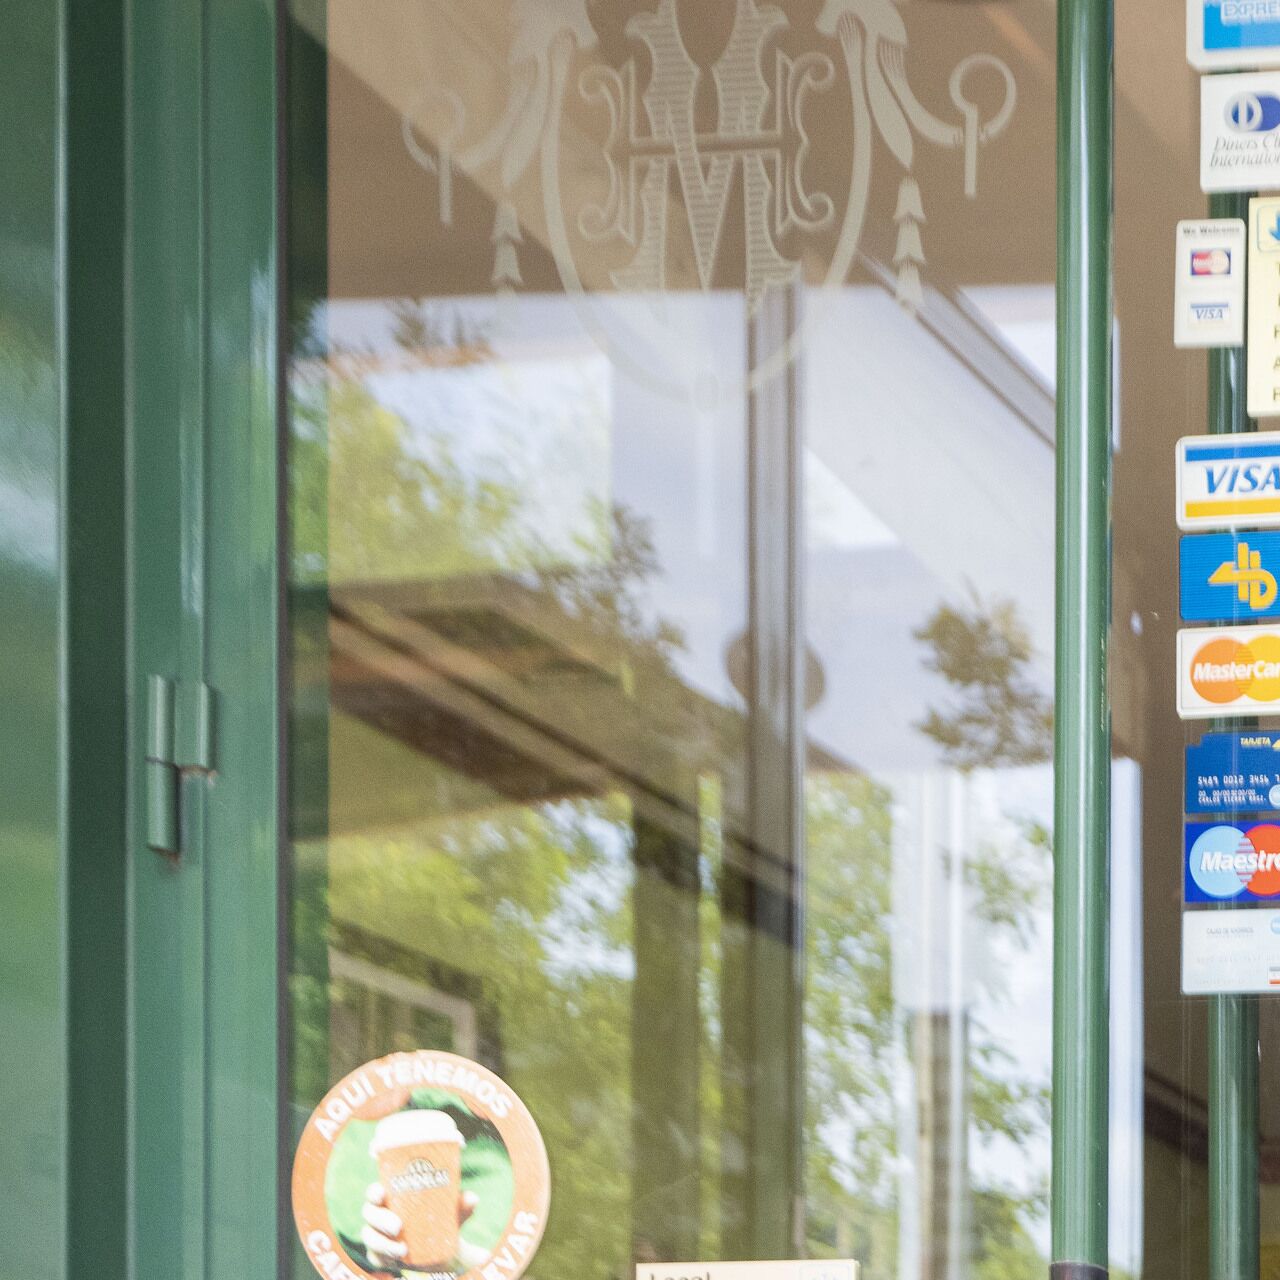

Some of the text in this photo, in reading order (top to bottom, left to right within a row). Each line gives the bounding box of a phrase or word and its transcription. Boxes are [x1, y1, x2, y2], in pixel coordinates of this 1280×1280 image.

[1213, 136, 1258, 151] Diners
[1196, 308, 1224, 320] VISA
[373, 1059, 513, 1118] TENEMOS
